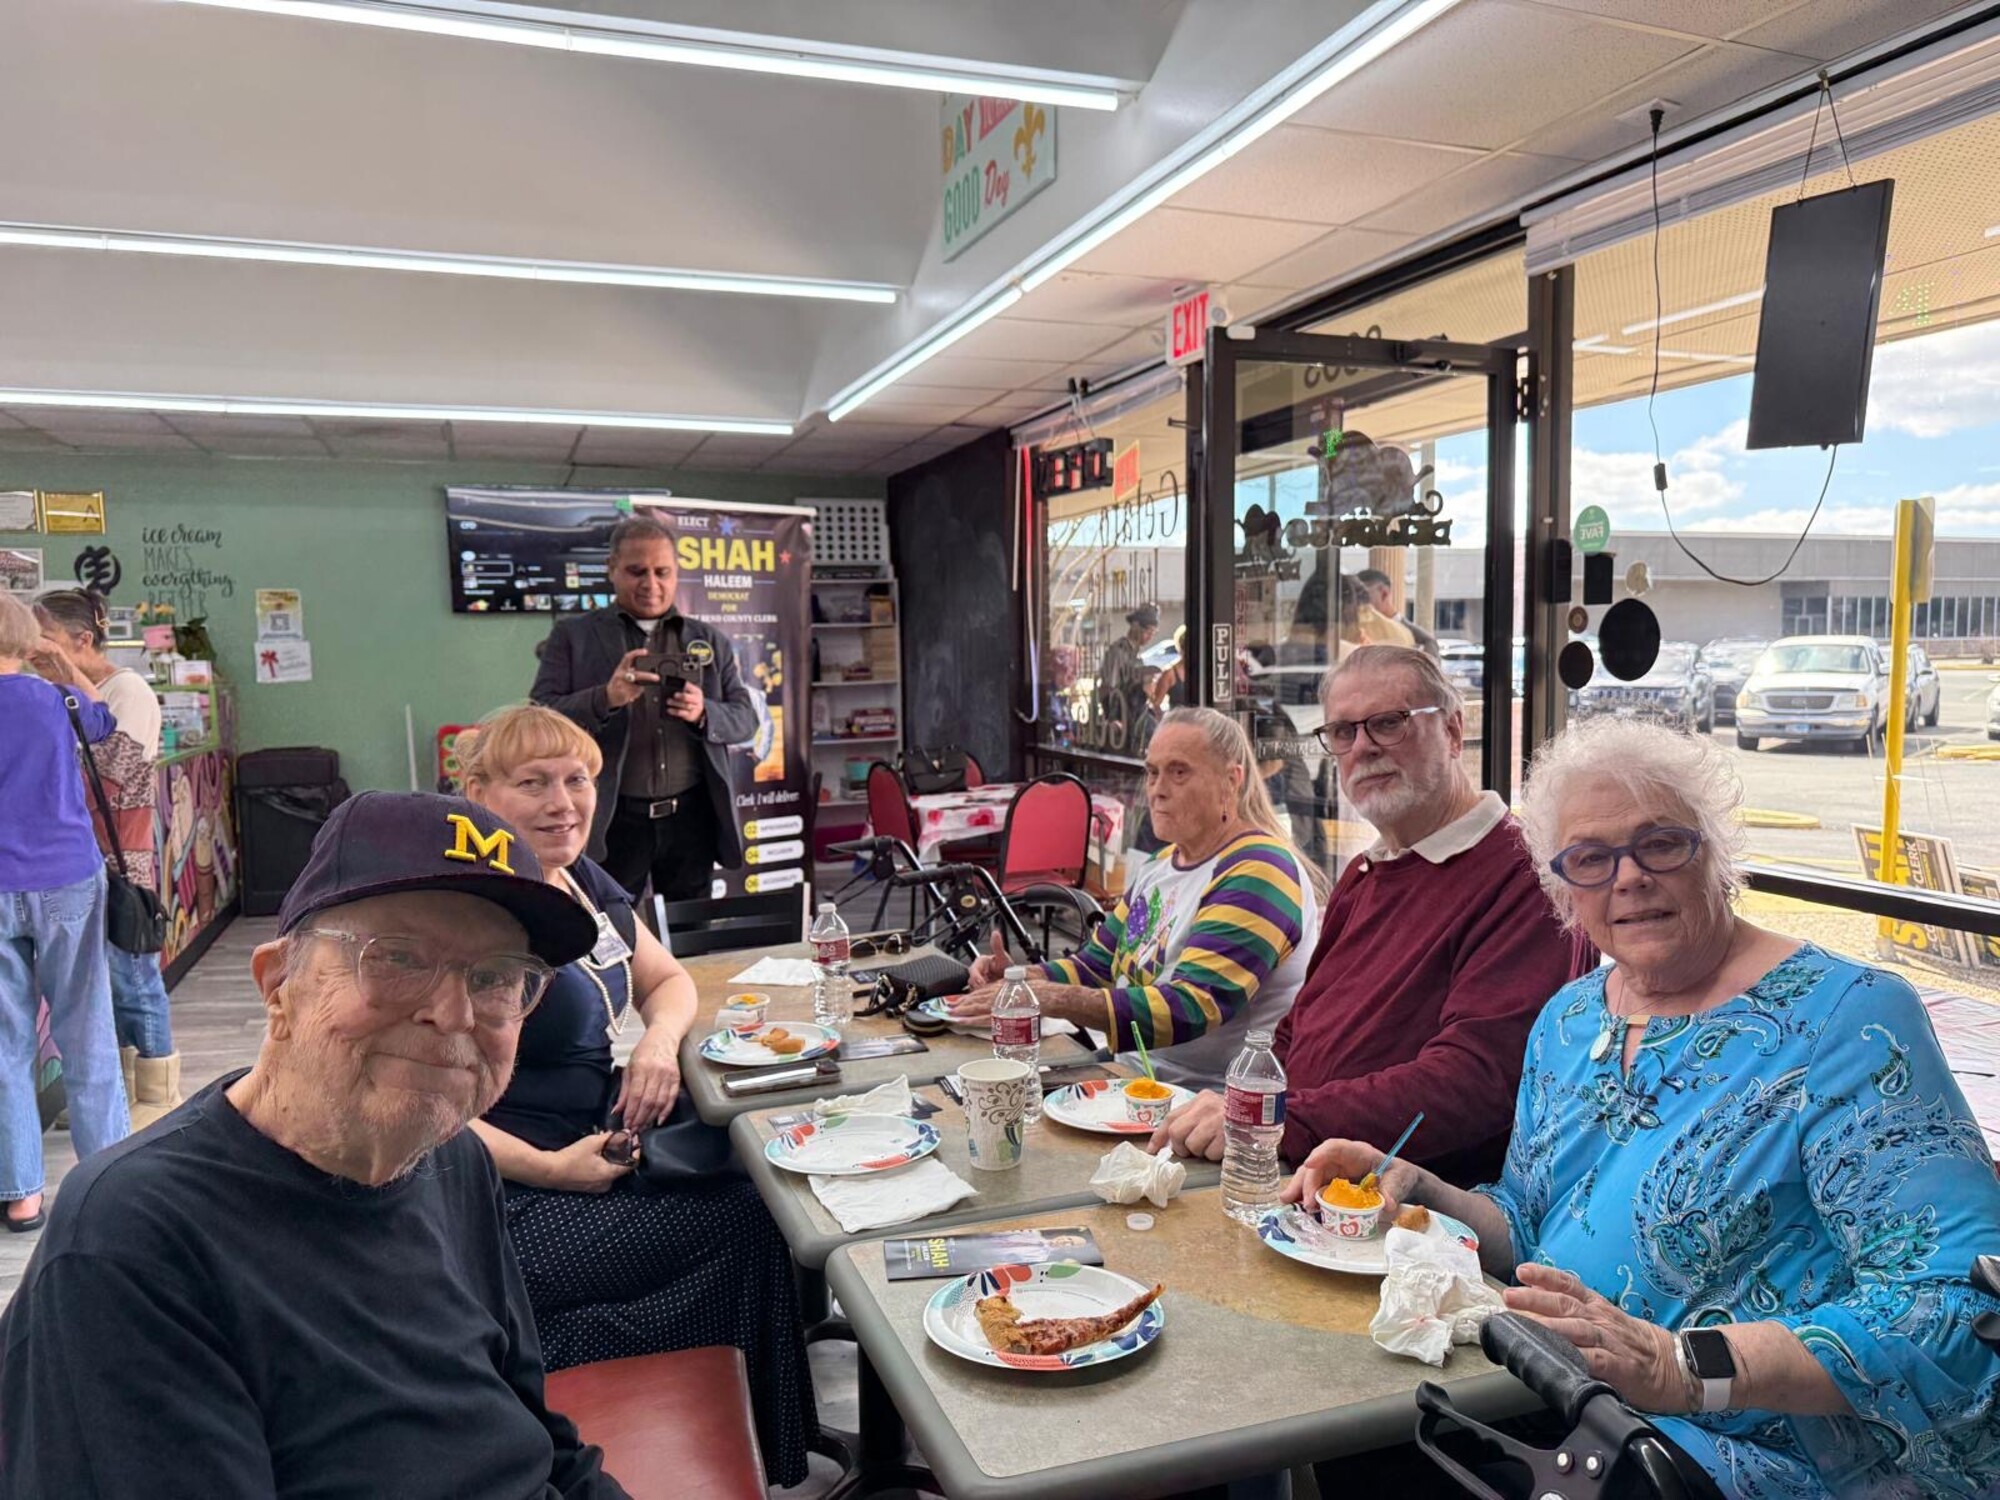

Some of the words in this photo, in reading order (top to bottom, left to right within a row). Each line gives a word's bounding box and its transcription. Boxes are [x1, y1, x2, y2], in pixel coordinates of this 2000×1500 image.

[1173, 291, 1209, 359] EXIT
[142, 527, 168, 544] ice
[171, 523, 222, 549] cream
[678, 515, 709, 528] ELECT
[143, 546, 193, 573] MAKES
[677, 536, 776, 572] SHAH
[142, 569, 234, 598] everything
[704, 574, 753, 589] HALEEM
[1216, 628, 1229, 698] PULL
[444, 814, 515, 875] M
[1905, 840, 1925, 885] CLERK
[928, 1239, 950, 1268] SHAH
